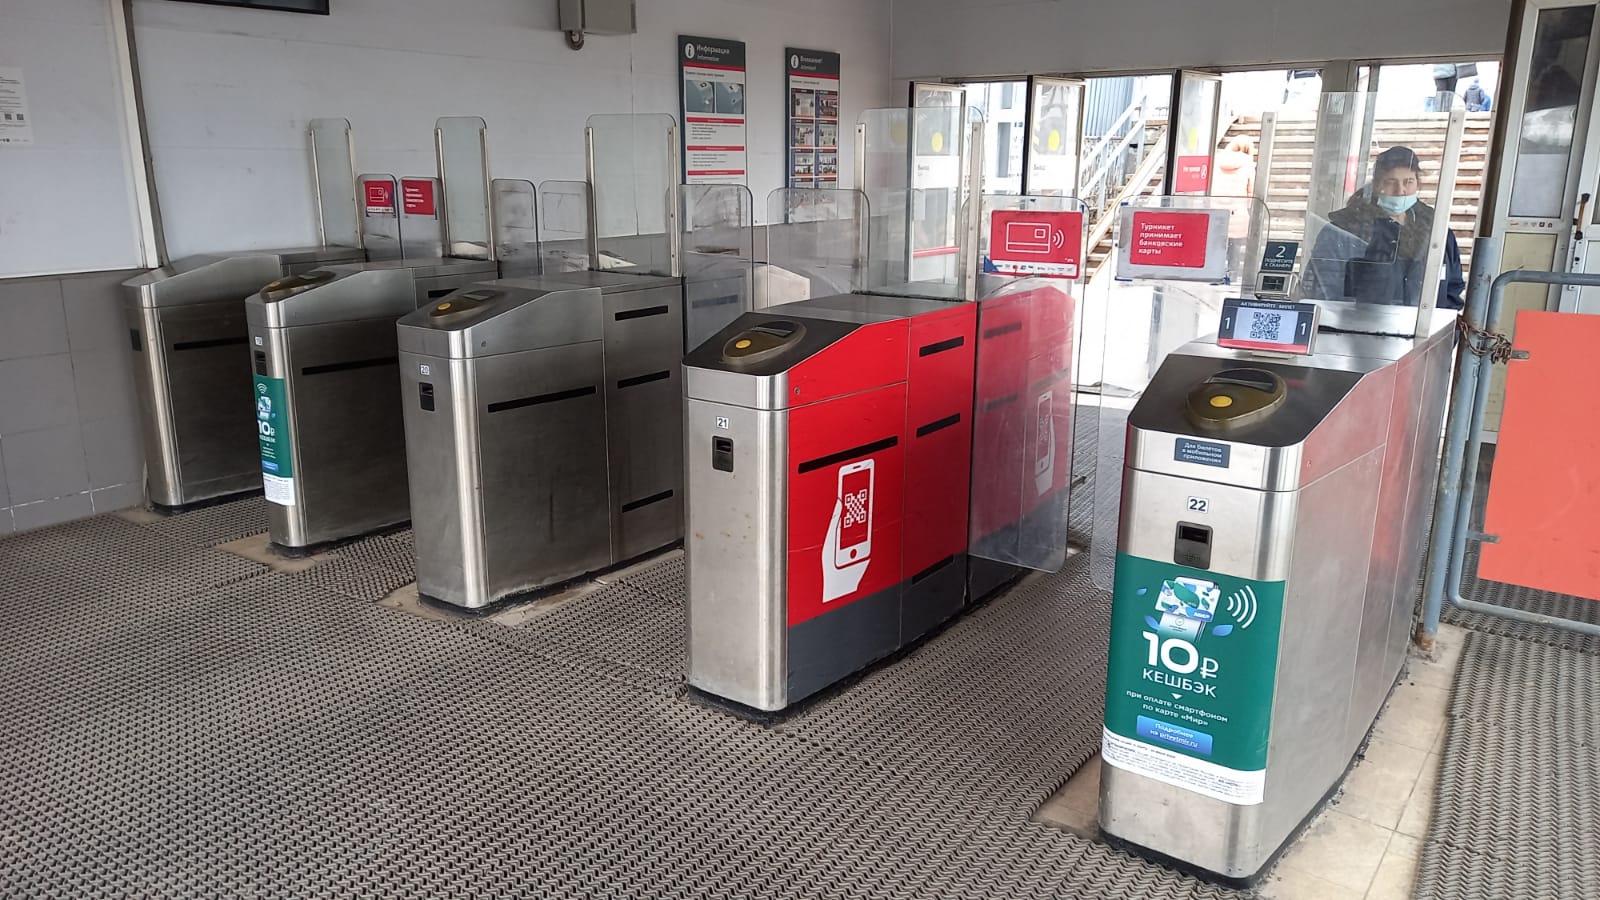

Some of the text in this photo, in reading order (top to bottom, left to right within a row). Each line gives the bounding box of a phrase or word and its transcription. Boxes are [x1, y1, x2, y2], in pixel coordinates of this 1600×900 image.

[1141, 222, 1175, 231] Турникет
[1139, 239, 1183, 247] банковские
[1275, 245, 1286, 258] 2
[1225, 316, 1232, 330] 1
[1300, 322, 1307, 336] 1
[718, 418, 727, 428] 21
[1187, 449, 1222, 458] мобильном
[1196, 443, 1222, 453] билетов
[1189, 498, 1207, 512] 22
[1142, 668, 1217, 698] КЕШБЭК
[1126, 690, 1228, 723] при оплате смартфоном
[1142, 703, 1208, 726] по карте «Мир»
[1155, 723, 1194, 738] Подробнее
